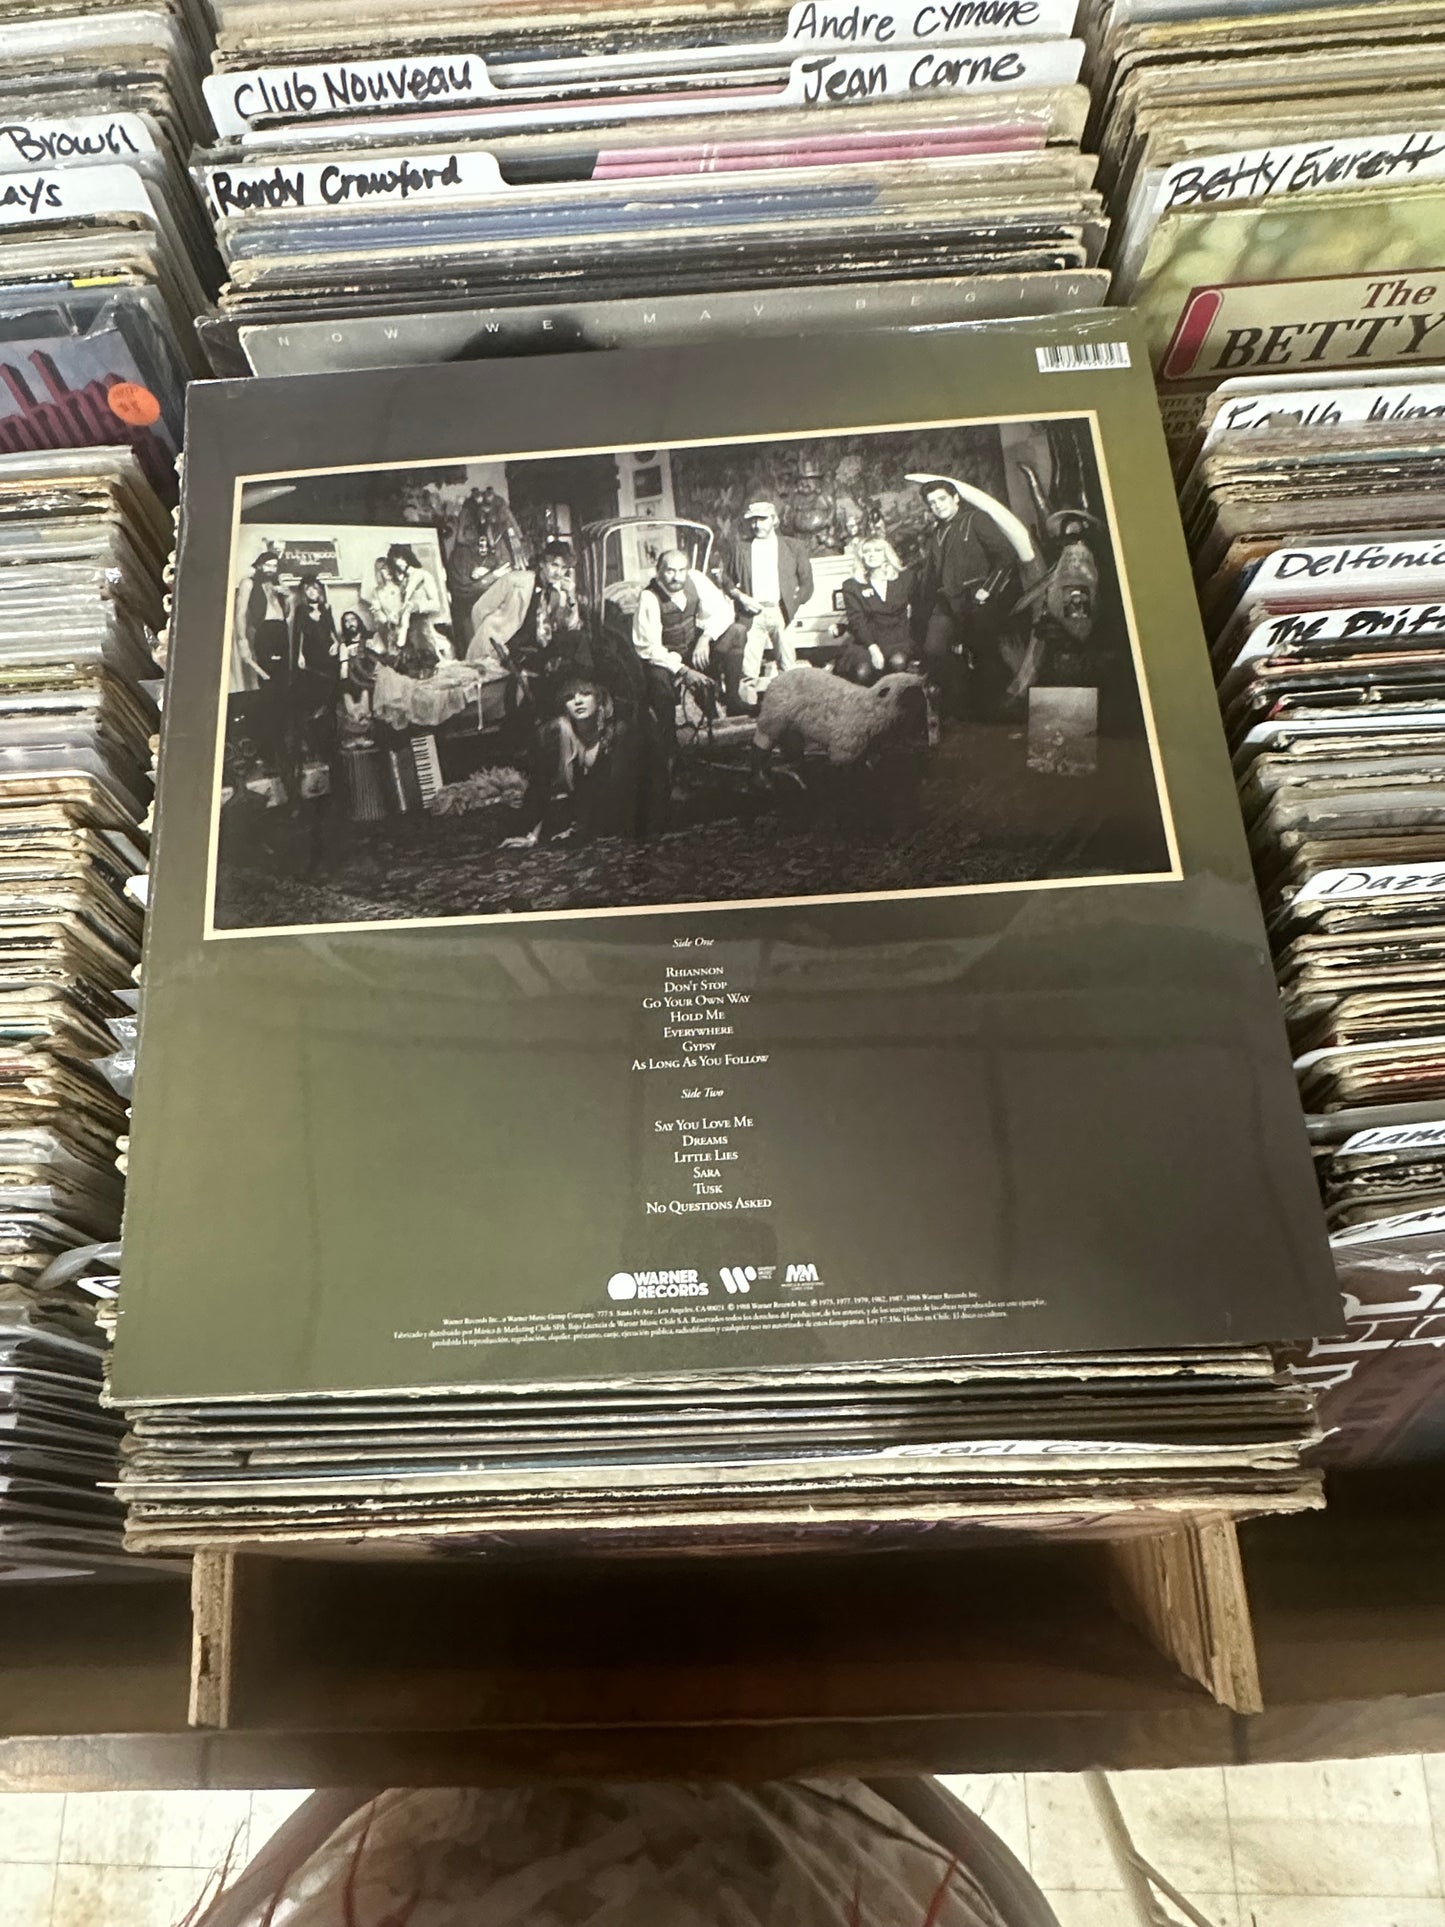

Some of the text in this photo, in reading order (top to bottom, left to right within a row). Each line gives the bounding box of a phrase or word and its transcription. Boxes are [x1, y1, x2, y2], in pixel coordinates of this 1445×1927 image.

[795, 3, 895, 42] Andre
[234, 60, 473, 120] Club Nouveau
[801, 53, 1027, 102] Jean Carne
[0, 125, 139, 161] Brown
[212, 154, 463, 216] Randy Crawford
[1164, 133, 1445, 210] Betty Everett
[1360, 279, 1438, 311] The
[1267, 615, 1329, 648] The
[672, 937, 714, 948] Side One
[681, 1087, 724, 1099] Side Two
[634, 1270, 698, 1286] WARNER
[638, 1282, 709, 1299] RECORDS
